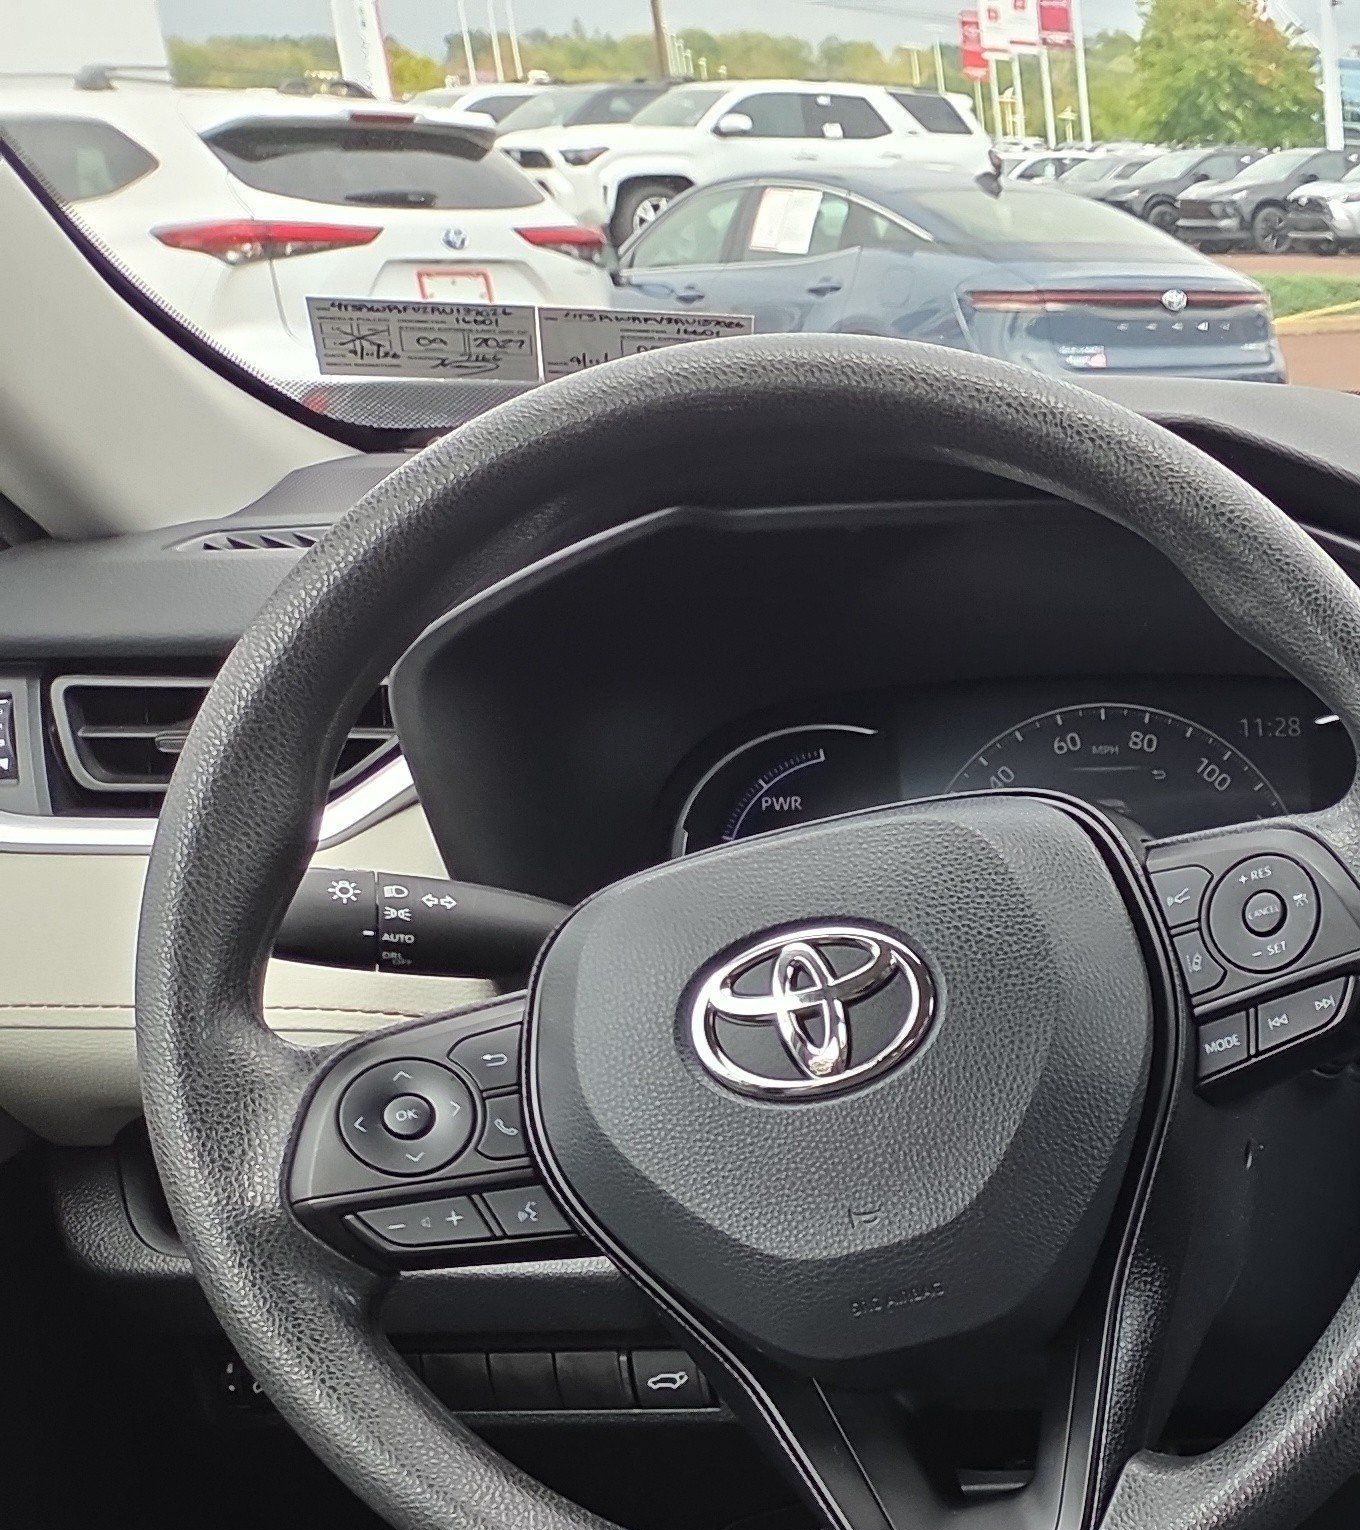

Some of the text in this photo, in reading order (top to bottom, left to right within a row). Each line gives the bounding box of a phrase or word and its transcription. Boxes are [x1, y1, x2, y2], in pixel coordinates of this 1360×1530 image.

[1240, 717, 1301, 737] 11:28
[1053, 731, 1157, 754] 60 80
[1092, 744, 1119, 755] MPH
[989, 765, 1015, 789] 40
[1196, 757, 1232, 791] 100
[761, 795, 803, 811] PWR
[1250, 865, 1272, 881] RES
[381, 933, 415, 944] AUTO
[1267, 940, 1286, 956] SET
[1204, 1034, 1241, 1054] MODE
[396, 1109, 418, 1121] OK
